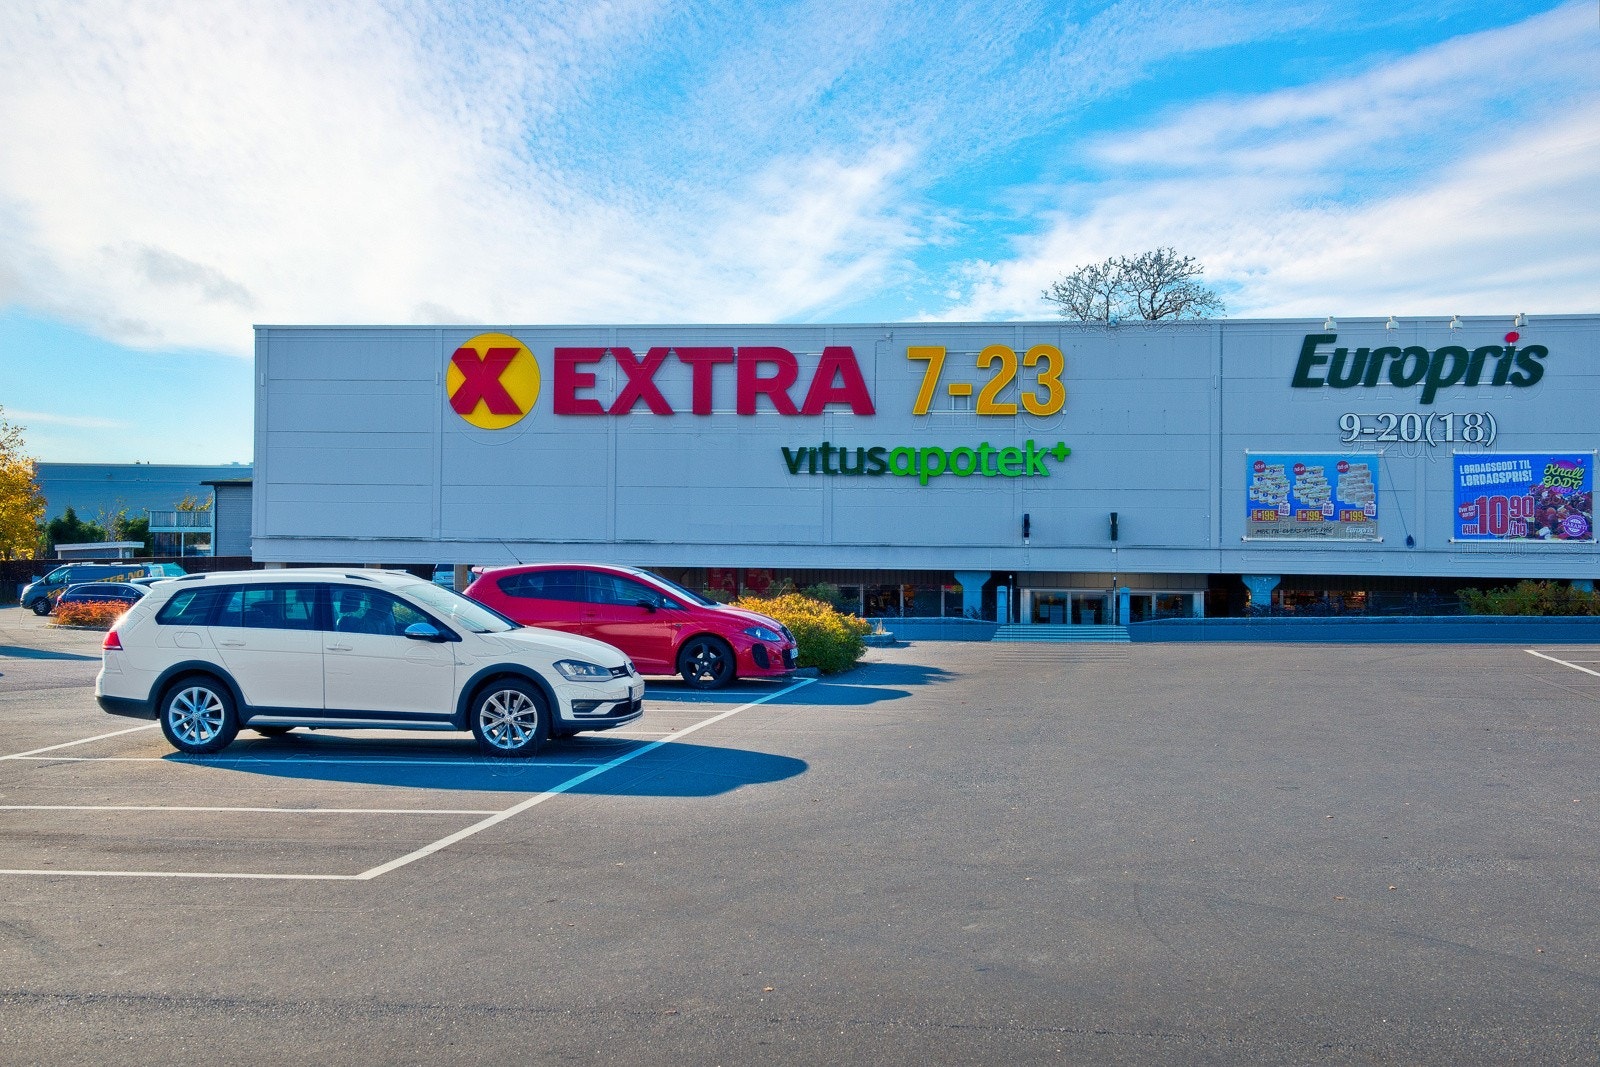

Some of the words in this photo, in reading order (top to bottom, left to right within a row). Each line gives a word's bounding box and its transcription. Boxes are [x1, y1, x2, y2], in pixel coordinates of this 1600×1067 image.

[1292, 332, 1549, 404] Europris
[554, 347, 876, 415] EXTRA
[907, 344, 1066, 416] 7-23
[1339, 412, 1498, 447] 9-20(18)
[1460, 461, 1517, 475] LØRDAGSGODT
[1519, 460, 1532, 470] TIL
[1544, 463, 1585, 479] Knall
[1461, 470, 1533, 486] LØRDAGSPRIS!
[1462, 524, 1478, 535] KUN
